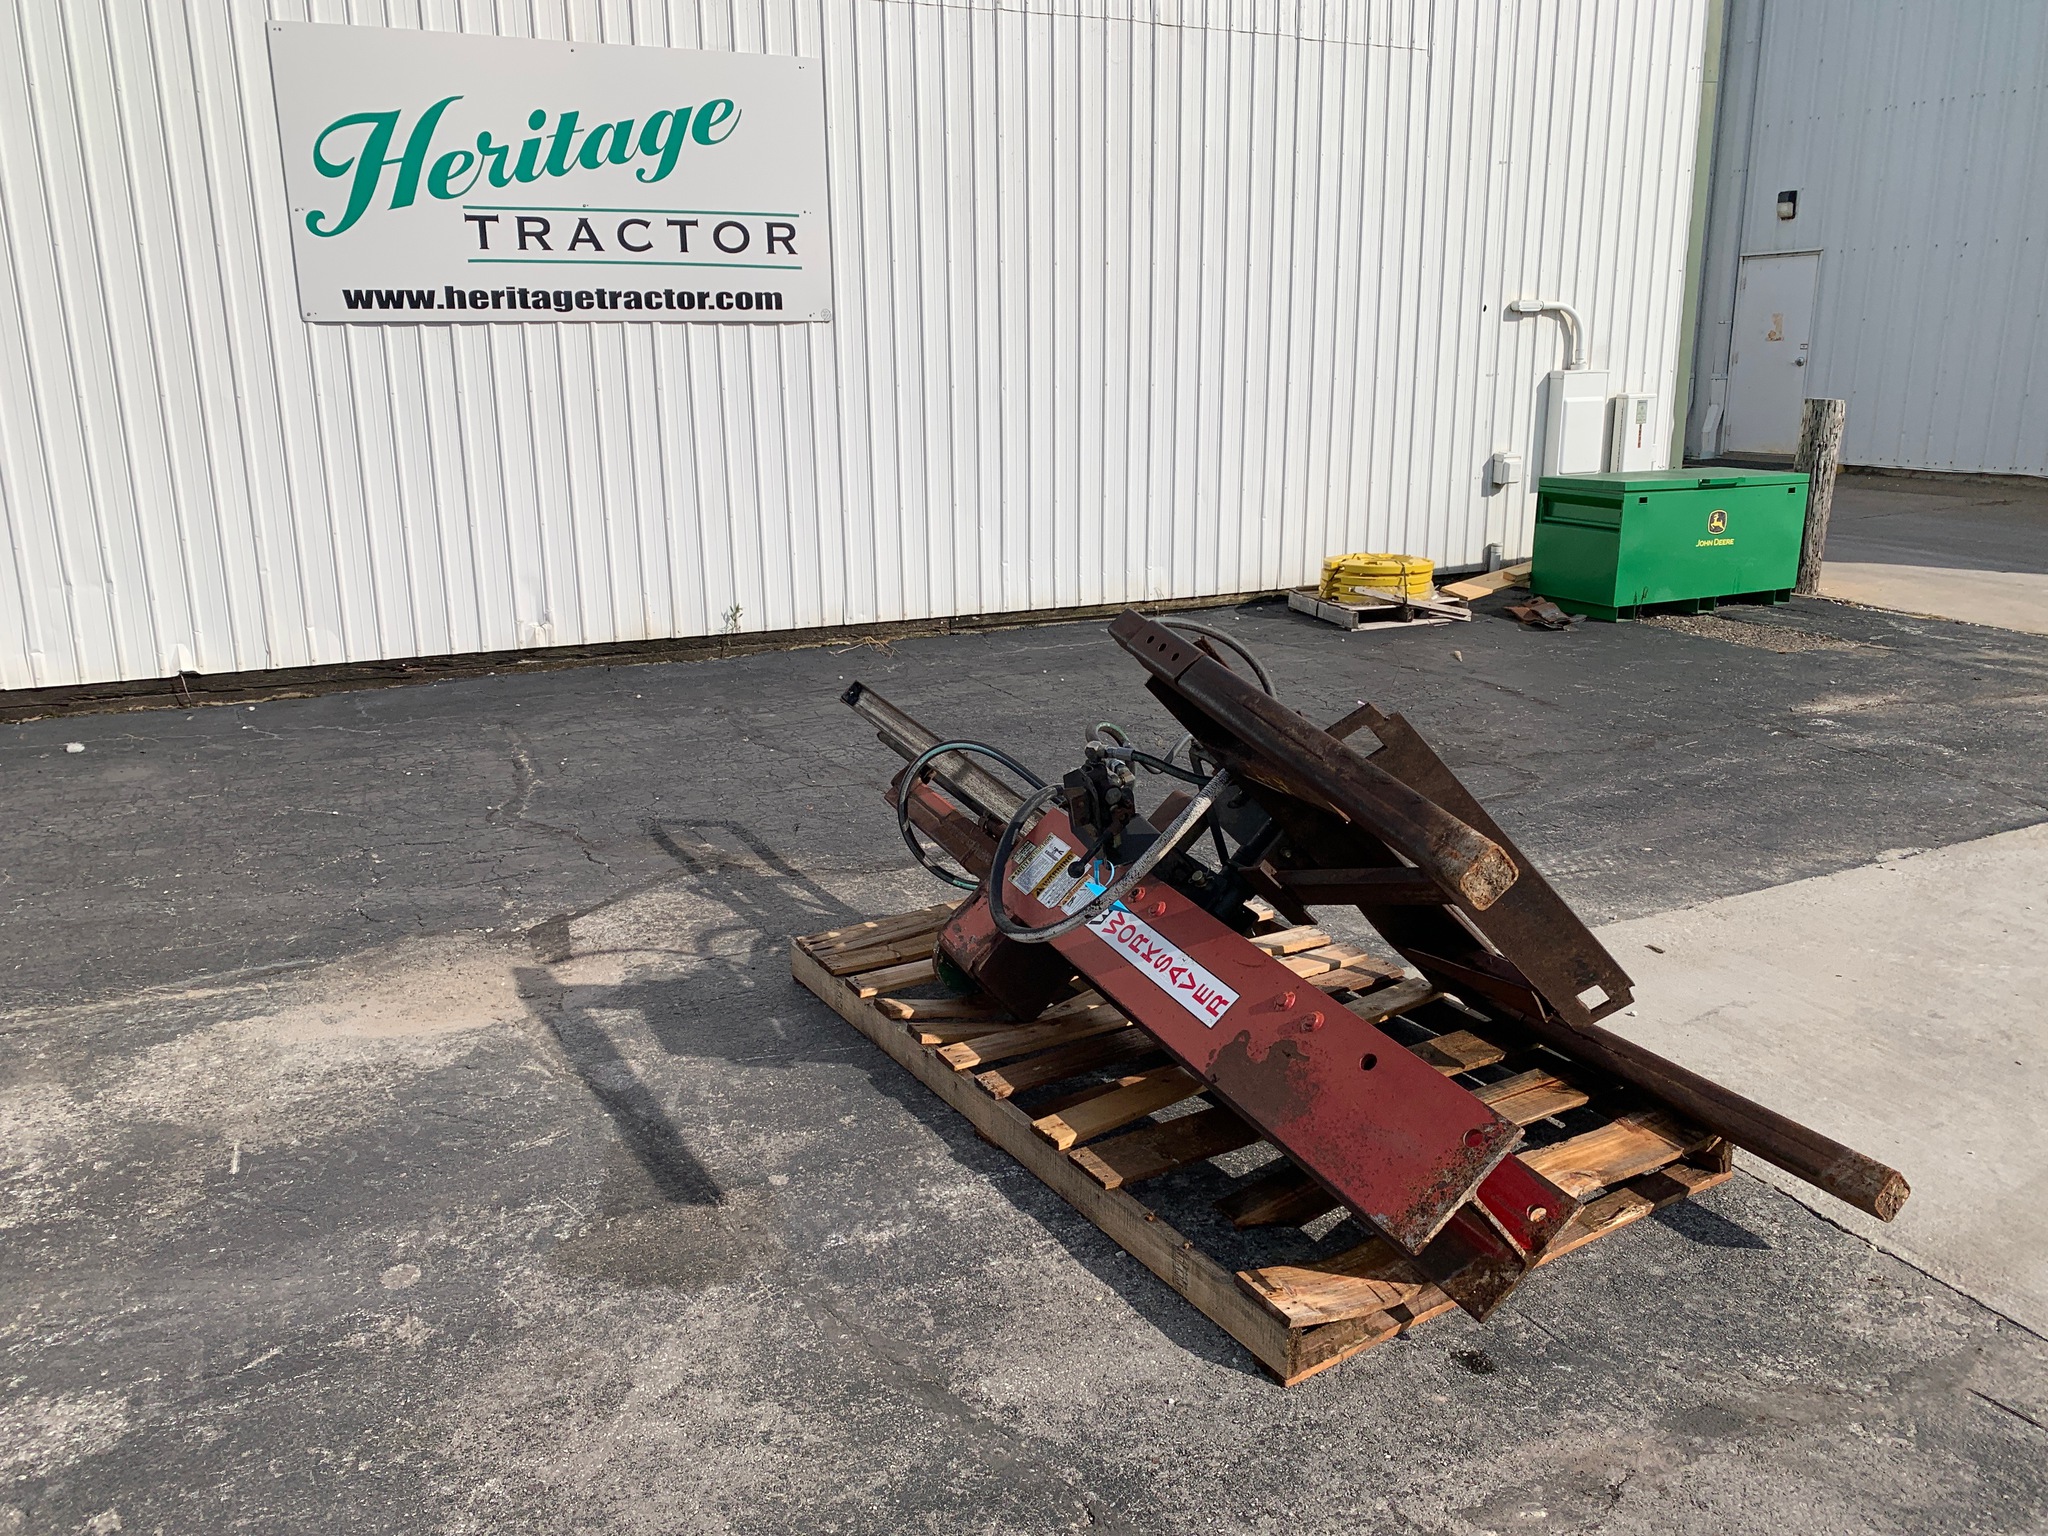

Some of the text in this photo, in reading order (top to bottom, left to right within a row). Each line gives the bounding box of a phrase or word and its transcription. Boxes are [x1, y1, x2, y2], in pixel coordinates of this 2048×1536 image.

[305, 95, 742, 238] Heritage
[463, 213, 798, 255] TRACTOR
[342, 286, 783, 312] www.heritagetractor.com
[1041, 853, 1074, 887] WARNING
[1101, 911, 1230, 1018] WORKSAVER
